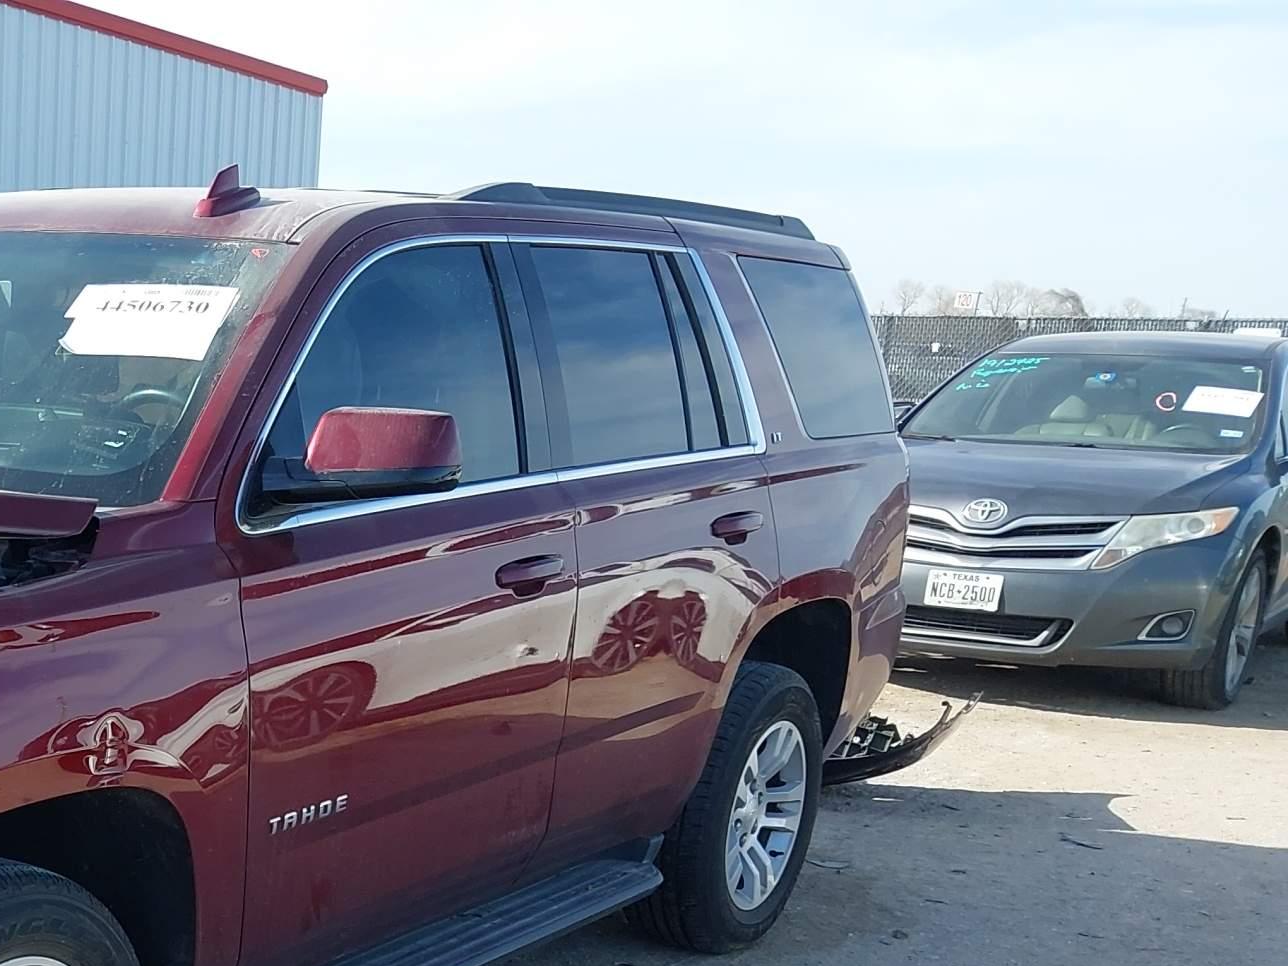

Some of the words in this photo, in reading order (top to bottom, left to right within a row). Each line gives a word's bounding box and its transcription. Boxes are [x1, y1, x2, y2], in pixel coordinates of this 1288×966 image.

[95, 299, 211, 314] 44506730
[952, 573, 980, 583] TEXAS
[268, 794, 349, 835] TAHOE
